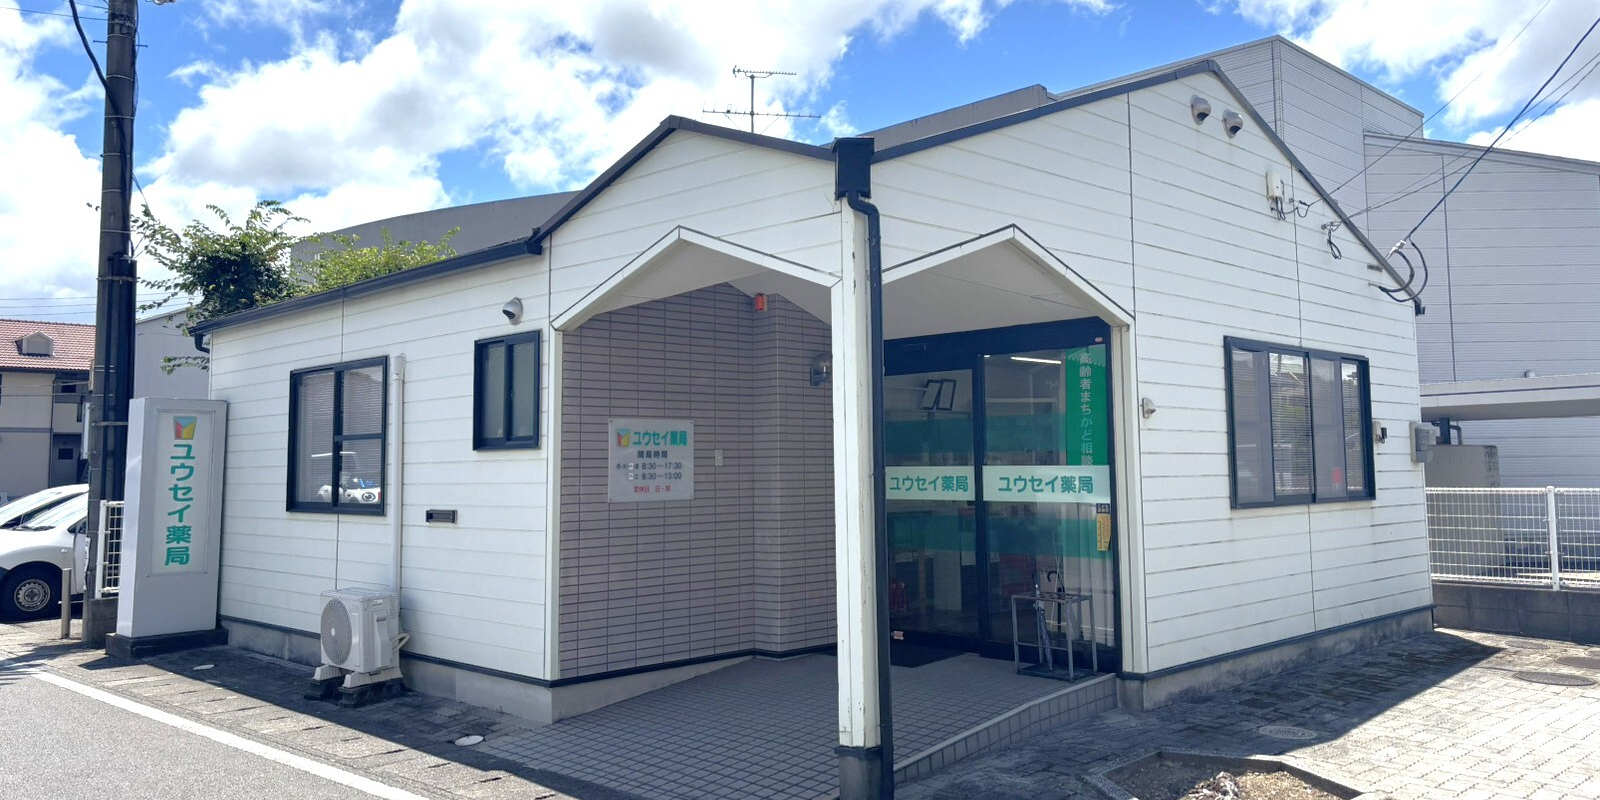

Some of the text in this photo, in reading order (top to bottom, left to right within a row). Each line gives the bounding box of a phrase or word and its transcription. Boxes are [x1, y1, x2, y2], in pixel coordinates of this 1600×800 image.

[633, 431, 687, 446] ユウセイ薬局
[637, 450, 668, 459] 開局時間
[889, 475, 969, 492] ユウセイ薬局
[998, 475, 1093, 494] ユウセイ薬局
[164, 444, 196, 566] ユウセイ薬局
